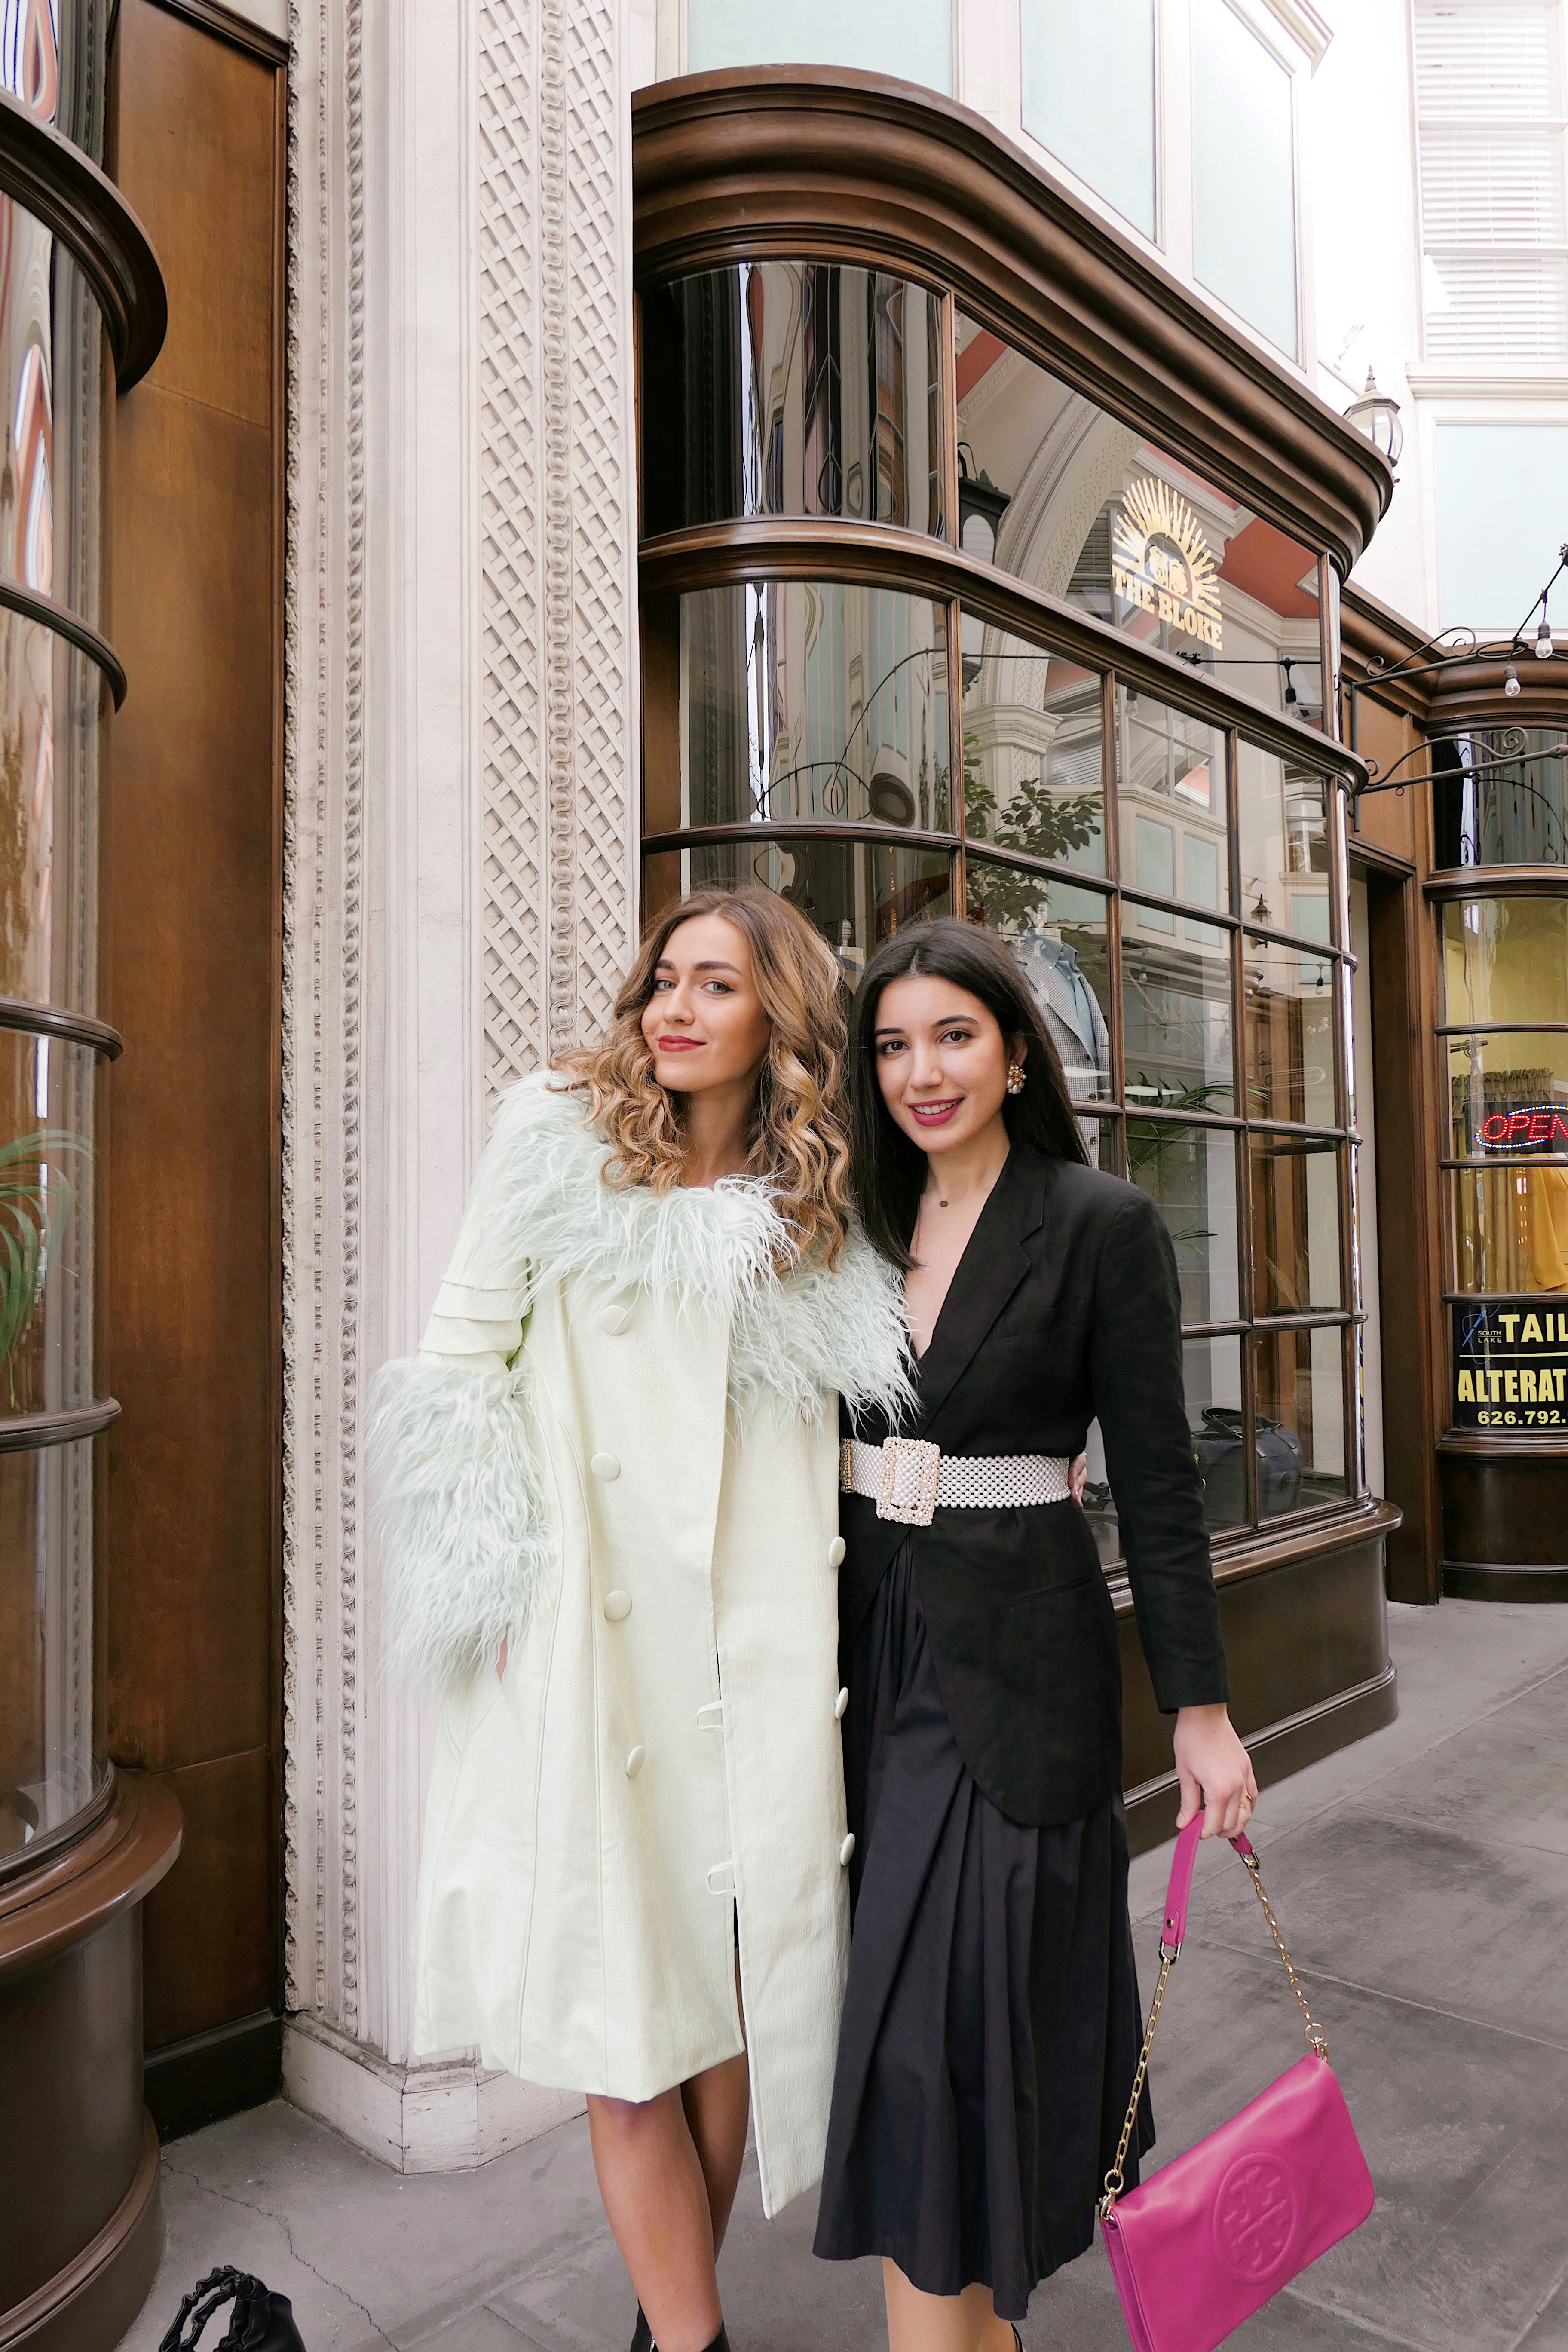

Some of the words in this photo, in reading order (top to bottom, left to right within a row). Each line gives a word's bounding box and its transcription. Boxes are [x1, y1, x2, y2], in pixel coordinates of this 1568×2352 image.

[1112, 564, 1155, 614] THE
[1158, 590, 1222, 651] BLOKE
[1484, 1114, 1568, 1140] OPEN
[1498, 1313, 1568, 1343] TAIL
[1458, 1369, 1568, 1402] ALTERAT
[1477, 1410, 1568, 1424] 626.792.
